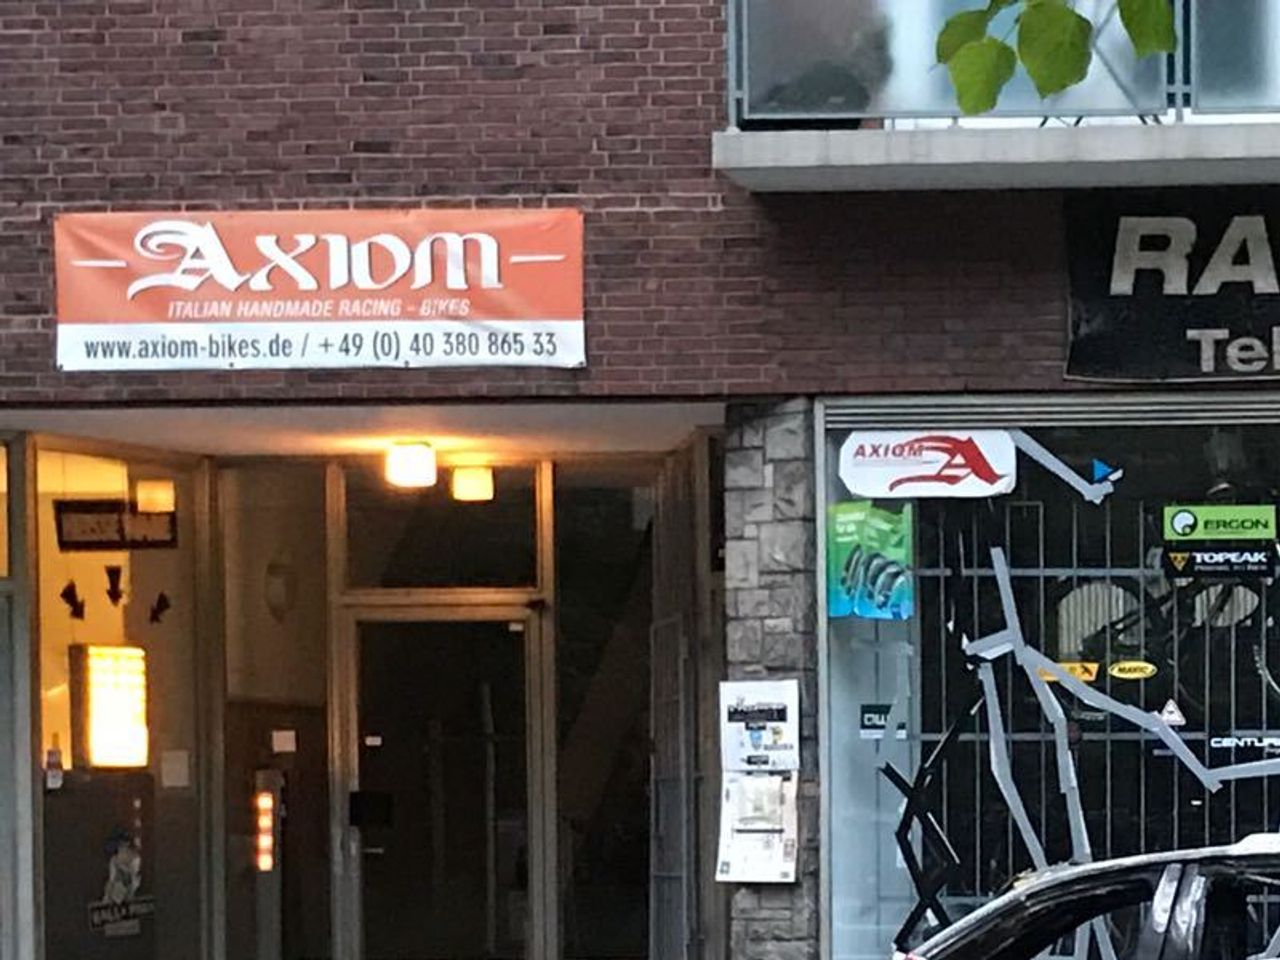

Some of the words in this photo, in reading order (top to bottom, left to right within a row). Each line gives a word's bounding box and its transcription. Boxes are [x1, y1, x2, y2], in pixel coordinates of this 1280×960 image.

[167, 300, 232, 318] ITALIAN
[236, 300, 332, 318] HANDMADE
[338, 298, 401, 317] RACING
[419, 298, 471, 317] BIKES
[84, 332, 293, 359] www.axiom-bikes.de
[372, 331, 400, 361] (0)
[409, 332, 434, 356] 40
[443, 332, 479, 356] 380
[487, 332, 525, 356] 865
[532, 331, 557, 356] 33
[853, 443, 925, 459] AXIOM
[1203, 518, 1269, 530] ERGON
[1192, 552, 1268, 564] TOPEAK
